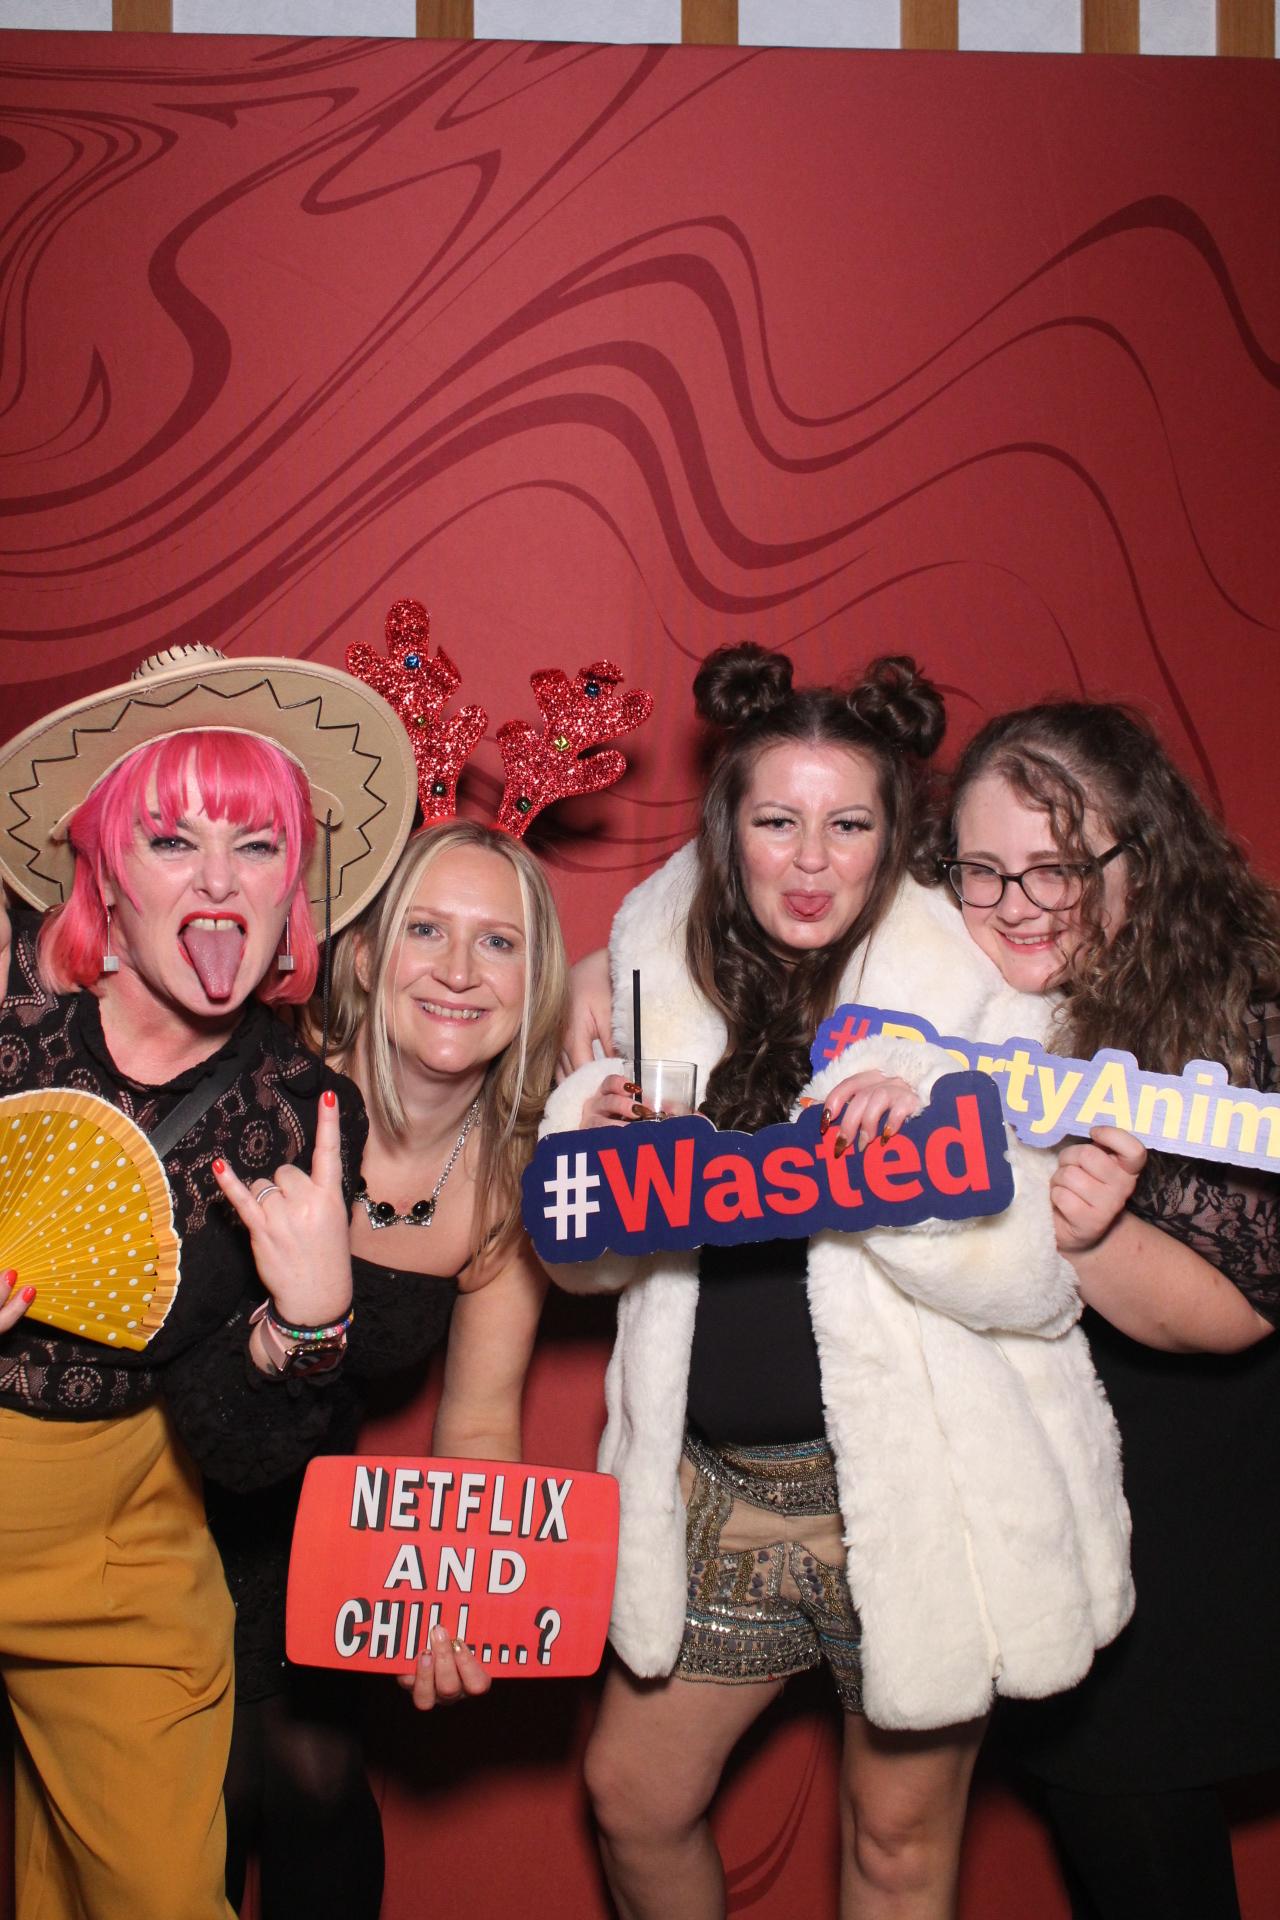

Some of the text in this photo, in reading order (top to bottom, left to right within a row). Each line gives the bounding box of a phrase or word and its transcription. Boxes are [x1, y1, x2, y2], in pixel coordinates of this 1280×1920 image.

[823, 1015, 1280, 1158] #tyAnim
[543, 1094, 990, 1240] #Wasted
[350, 1465, 573, 1541] NETFLIX
[383, 1544, 527, 1594] AND
